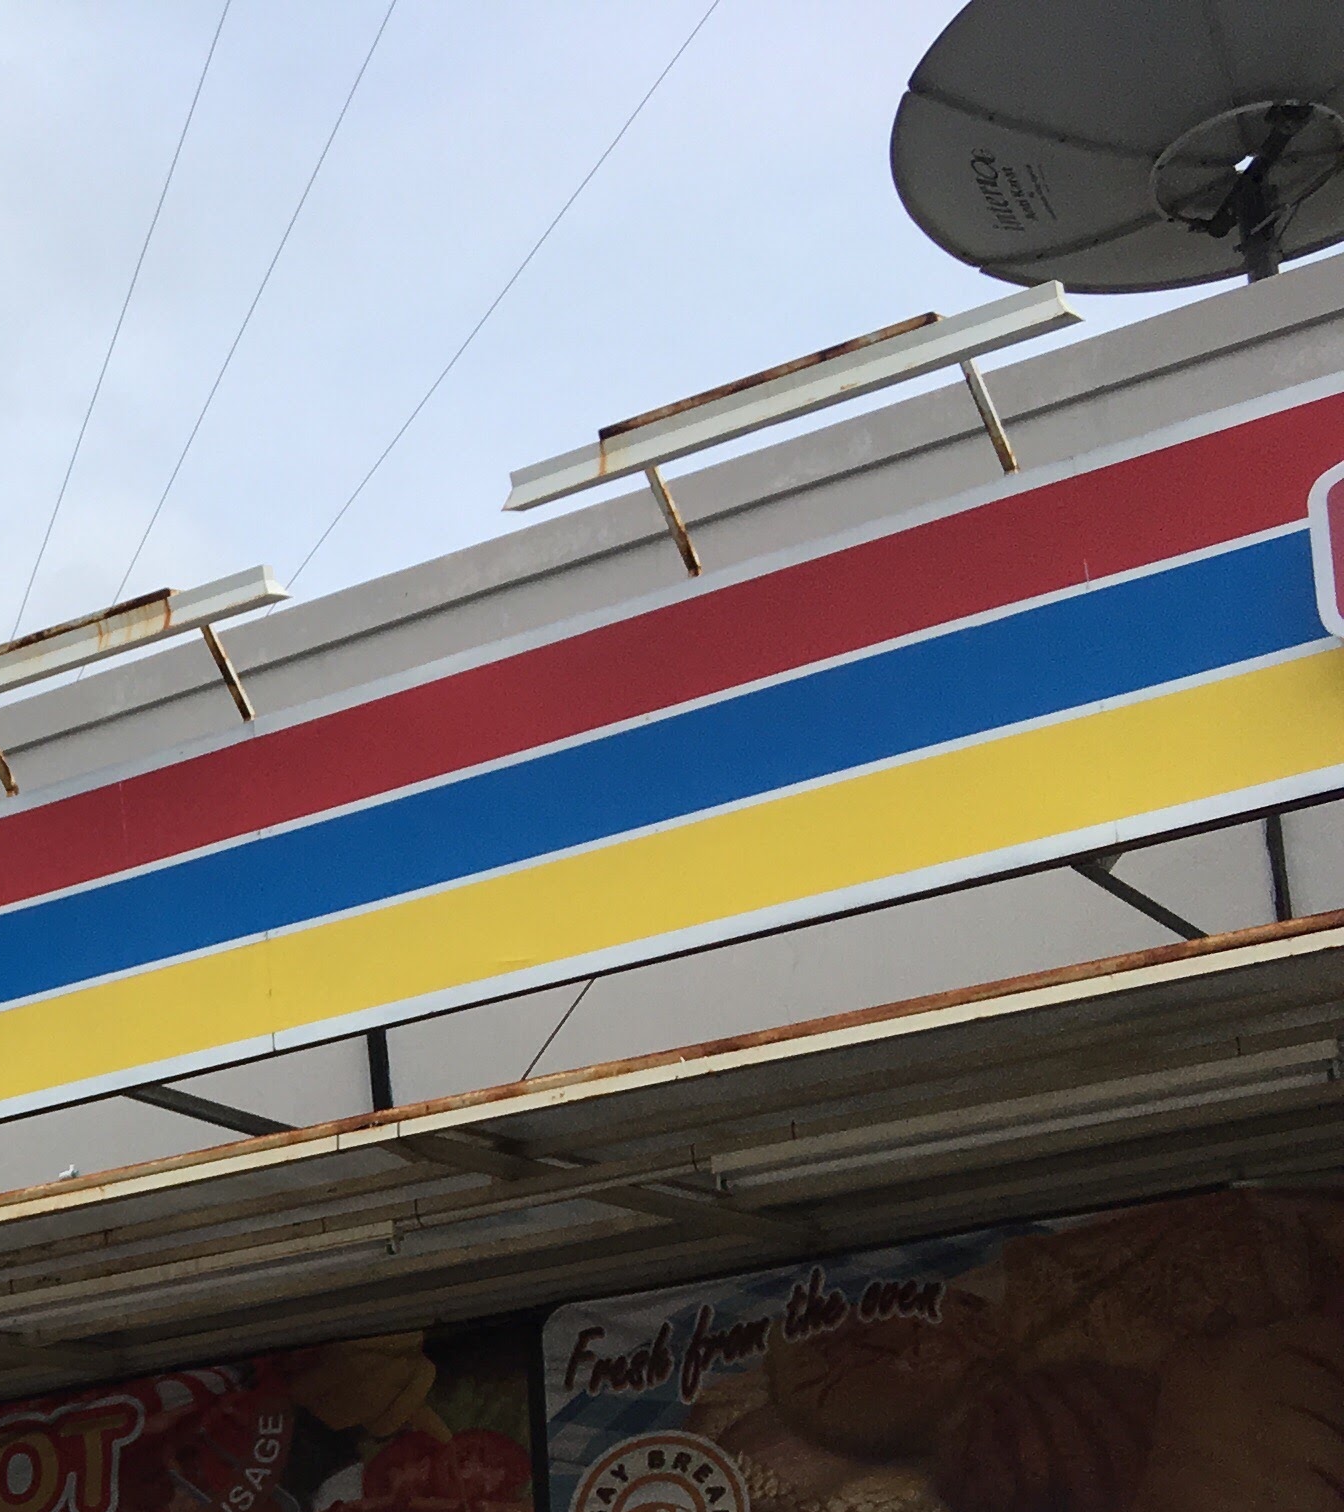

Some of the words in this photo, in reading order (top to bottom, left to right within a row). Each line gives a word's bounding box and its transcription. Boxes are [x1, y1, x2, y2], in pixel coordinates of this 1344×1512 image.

[563, 1321, 672, 1396] Fresh
[680, 1304, 771, 1405] from
[783, 1266, 850, 1341] the
[858, 1279, 946, 1323] oven
